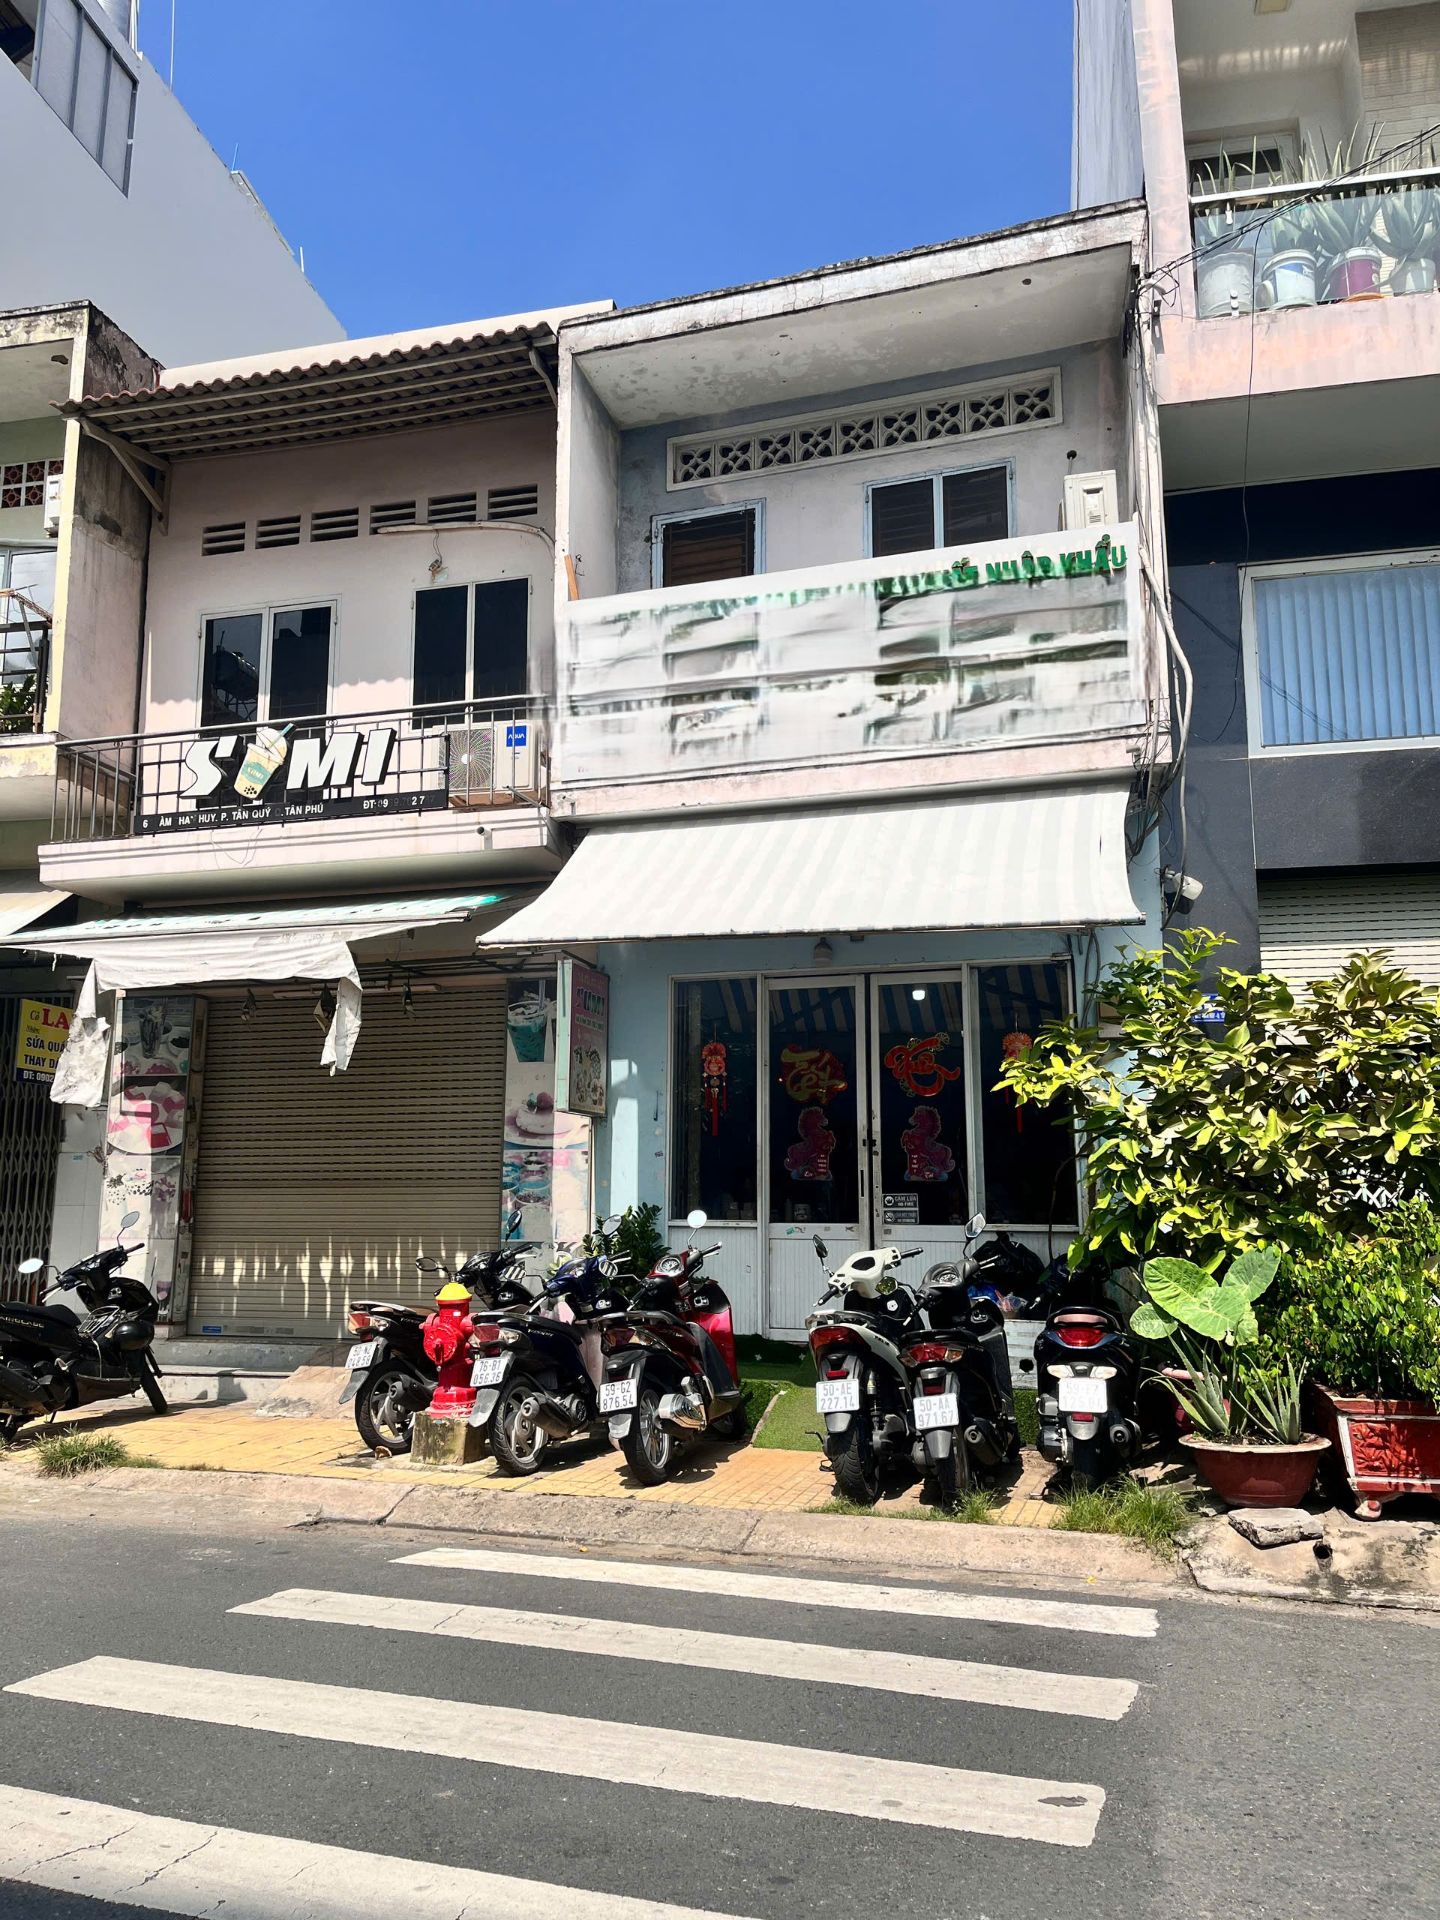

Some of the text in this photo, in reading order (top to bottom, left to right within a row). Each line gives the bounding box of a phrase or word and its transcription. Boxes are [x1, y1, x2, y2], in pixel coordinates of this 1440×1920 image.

[232, 809, 249, 821] TÂN
[304, 802, 324, 814] PHÚ
[24, 1054, 46, 1068] THAY
[605, 1381, 631, 1397] 59-G2
[823, 1382, 853, 1397] 50-AE
[602, 1394, 634, 1411] 876.54
[820, 1396, 855, 1411] 227.14
[918, 1410, 954, 1427] 971.67
